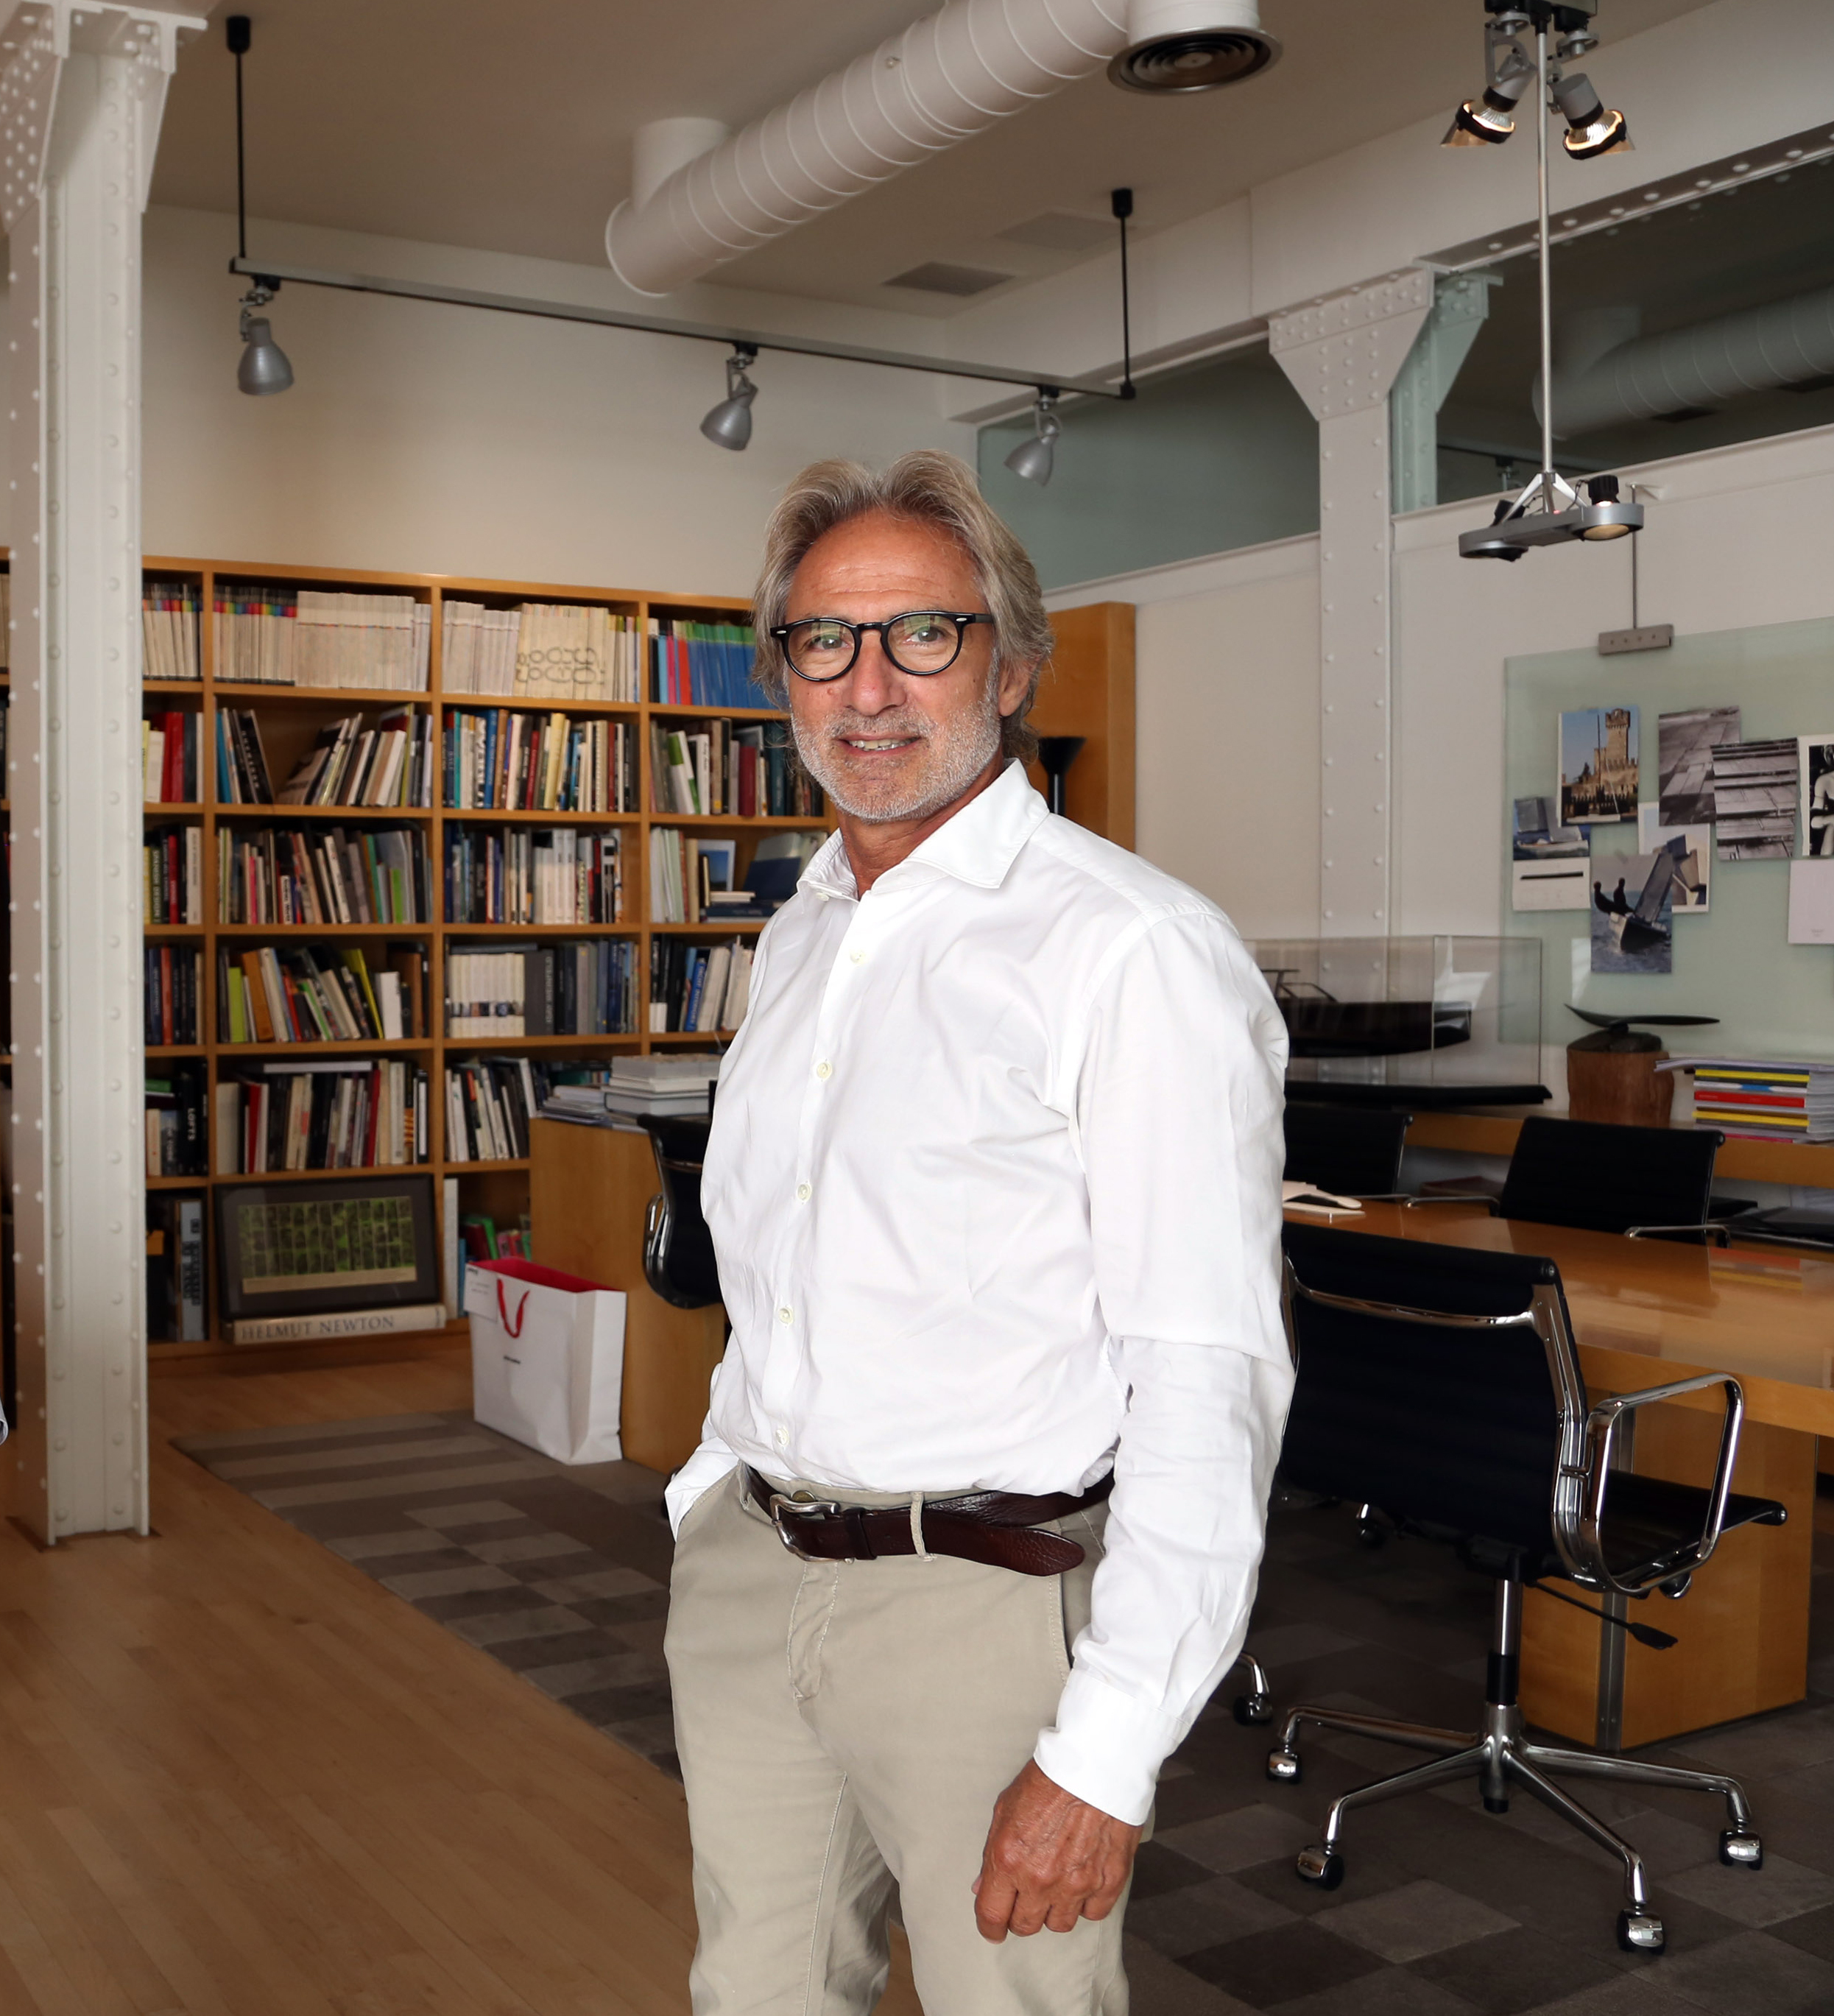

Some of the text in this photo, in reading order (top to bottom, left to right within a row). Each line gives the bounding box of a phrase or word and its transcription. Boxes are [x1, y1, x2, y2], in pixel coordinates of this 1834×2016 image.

[187, 1107, 196, 1141] LOFTS
[241, 1315, 395, 1340] HELMUT NEWTON
